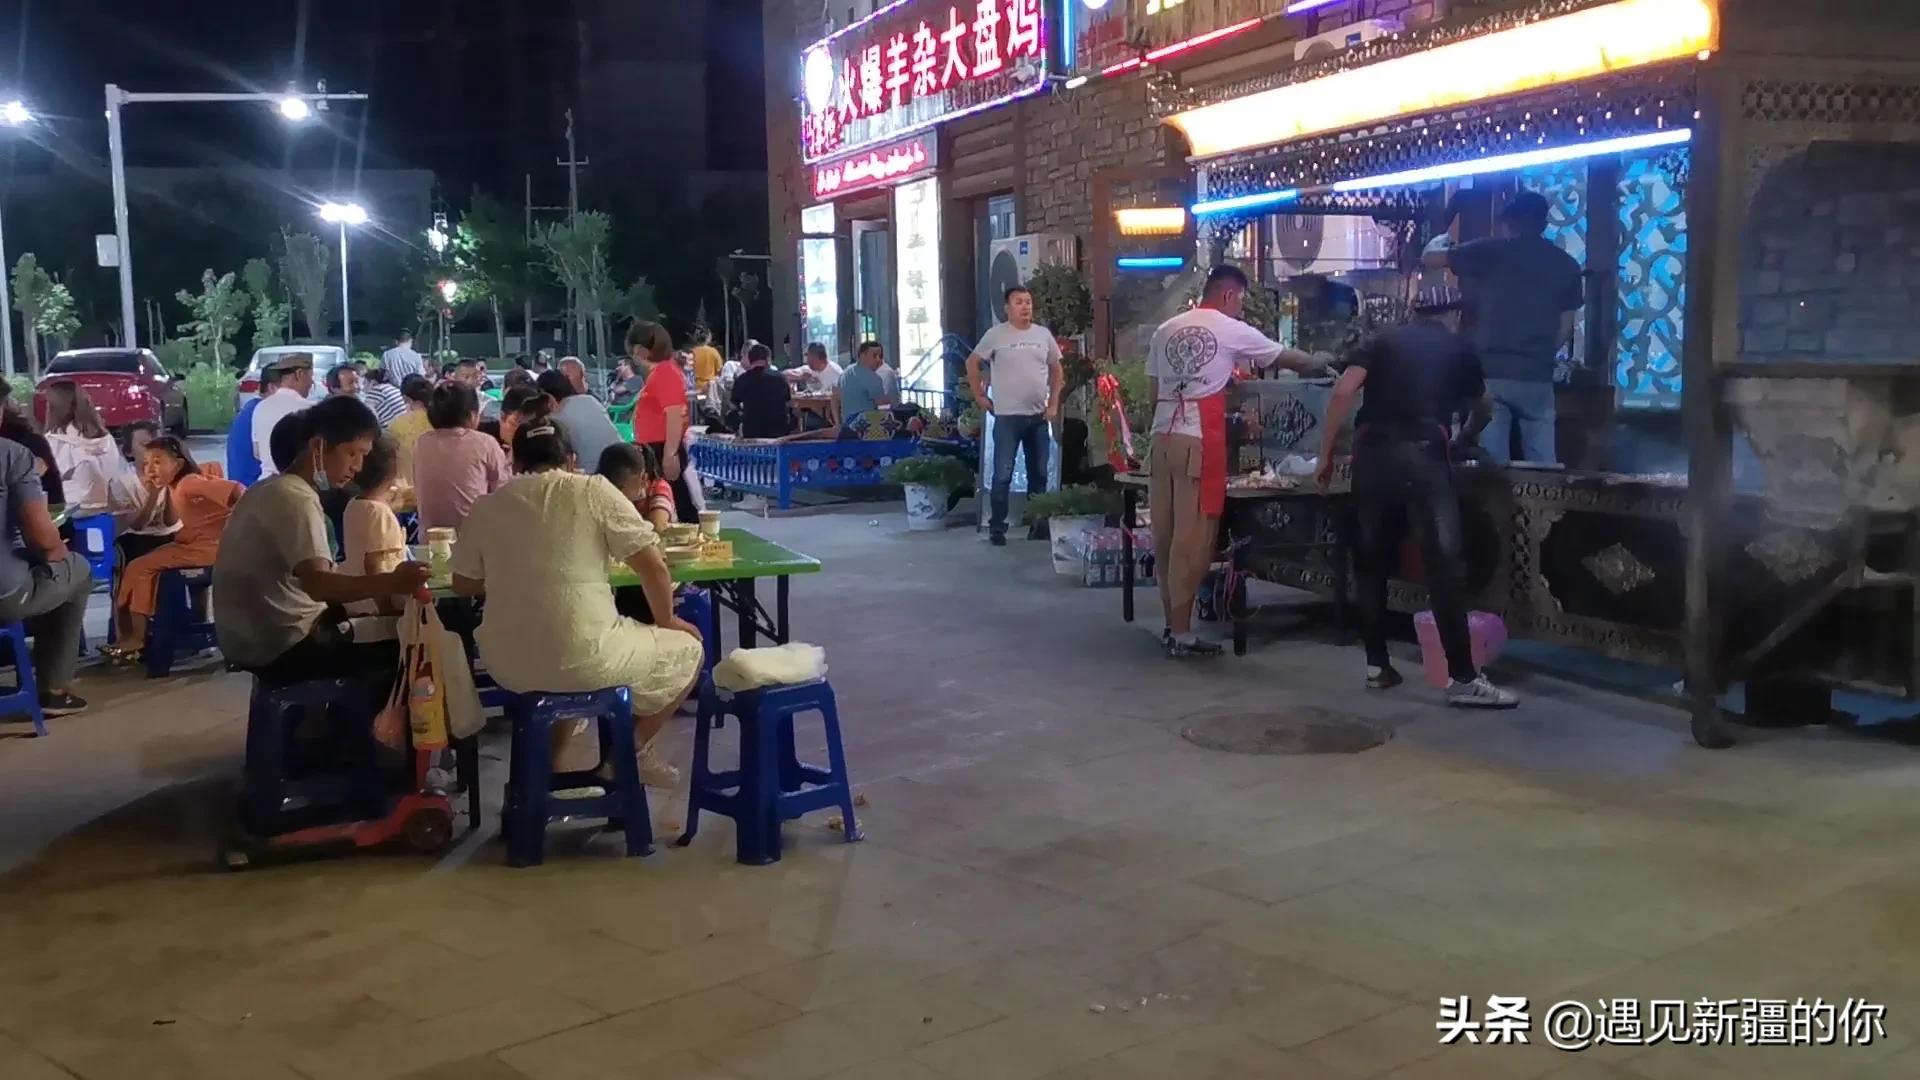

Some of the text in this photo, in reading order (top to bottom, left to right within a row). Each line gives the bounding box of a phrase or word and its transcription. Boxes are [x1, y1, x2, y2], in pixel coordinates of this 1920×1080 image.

[837, 0, 1040, 122] 火爆羊杂大盘鸡
